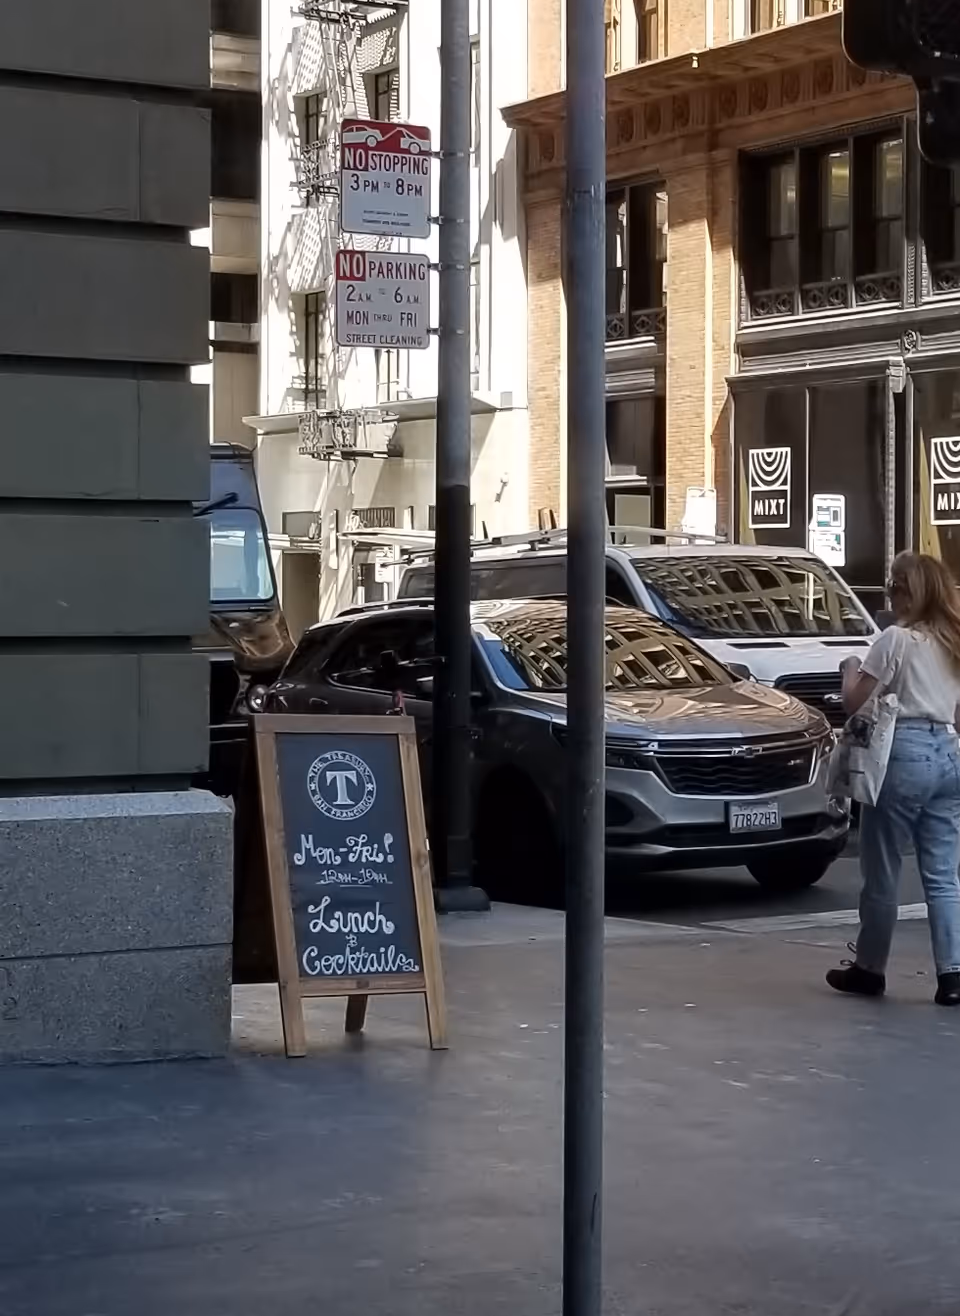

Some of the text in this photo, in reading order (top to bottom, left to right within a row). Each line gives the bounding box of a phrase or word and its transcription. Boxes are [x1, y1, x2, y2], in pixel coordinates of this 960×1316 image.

[344, 147, 429, 176] NO STOPPING
[350, 173, 360, 191] 3
[363, 179, 379, 193] PM
[396, 177, 405, 196] 8
[407, 183, 423, 197] PM
[339, 253, 426, 281] NO PARKING
[346, 284, 356, 302] 2
[394, 286, 403, 304] 6
[346, 310, 417, 327] MON THRU FRI
[346, 333, 423, 347] STREET CLEANING
[753, 498, 785, 516] MIXT
[326, 770, 358, 805] T
[307, 895, 396, 935] Lunch
[302, 945, 420, 975] Cocktails
